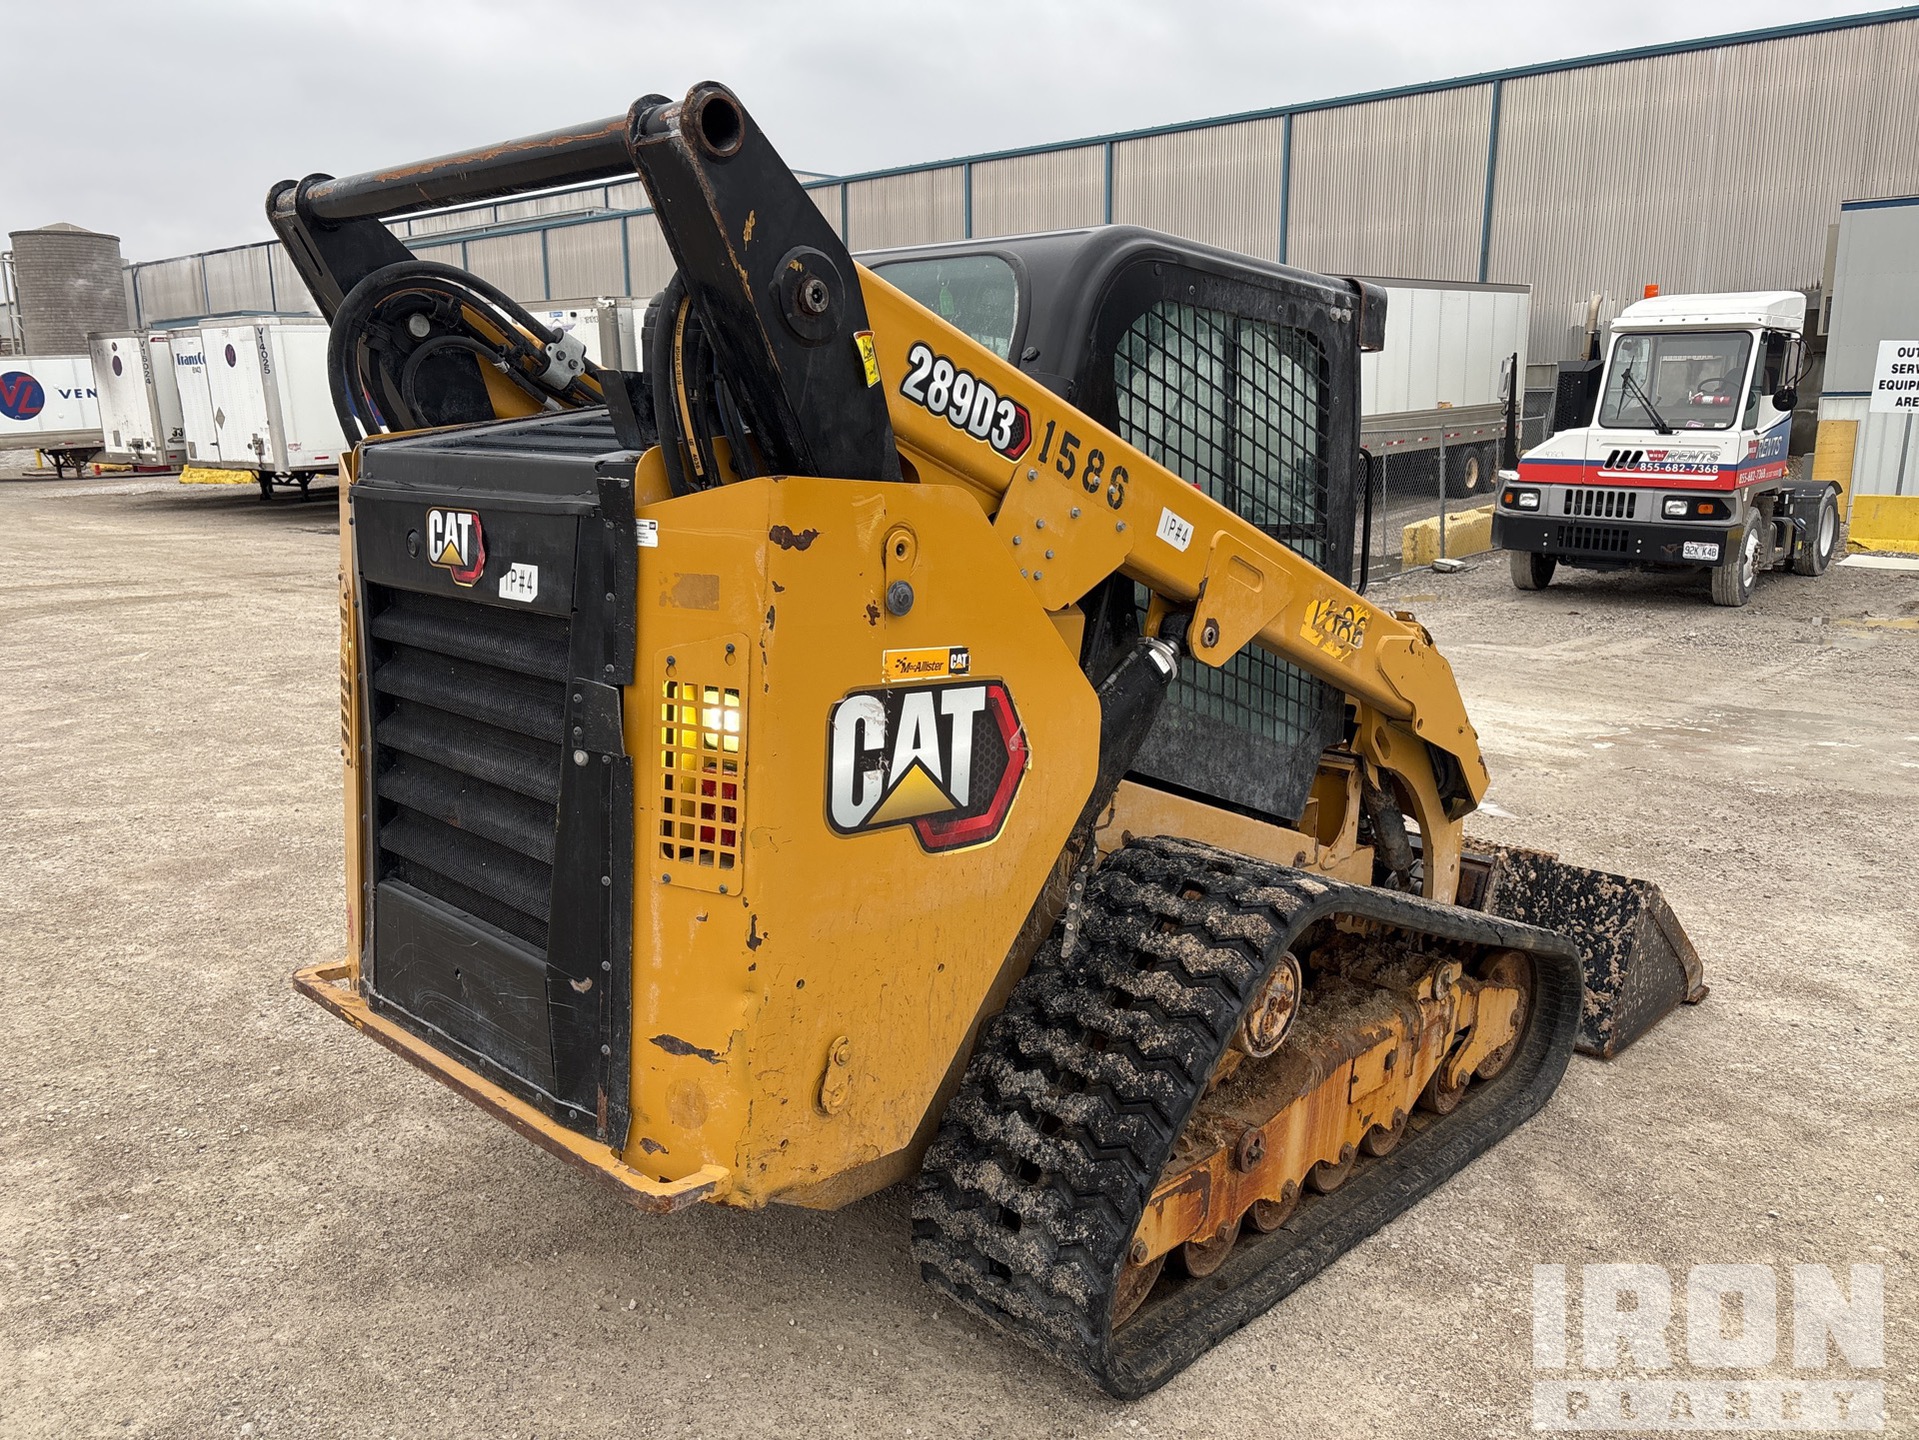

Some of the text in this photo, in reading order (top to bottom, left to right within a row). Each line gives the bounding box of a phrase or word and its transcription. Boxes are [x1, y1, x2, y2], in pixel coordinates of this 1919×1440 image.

[257, 327, 271, 374] V14025
[902, 346, 1016, 449] 289D3
[1879, 380, 1919, 391] EQUIP
[1038, 420, 1129, 509] 1586
[1640, 463, 1718, 473] 855-682-7368
[1666, 450, 1720, 463] RENTS
[429, 510, 473, 566] CAT
[950, 653, 967, 670] CAT
[831, 686, 986, 829] CAT
